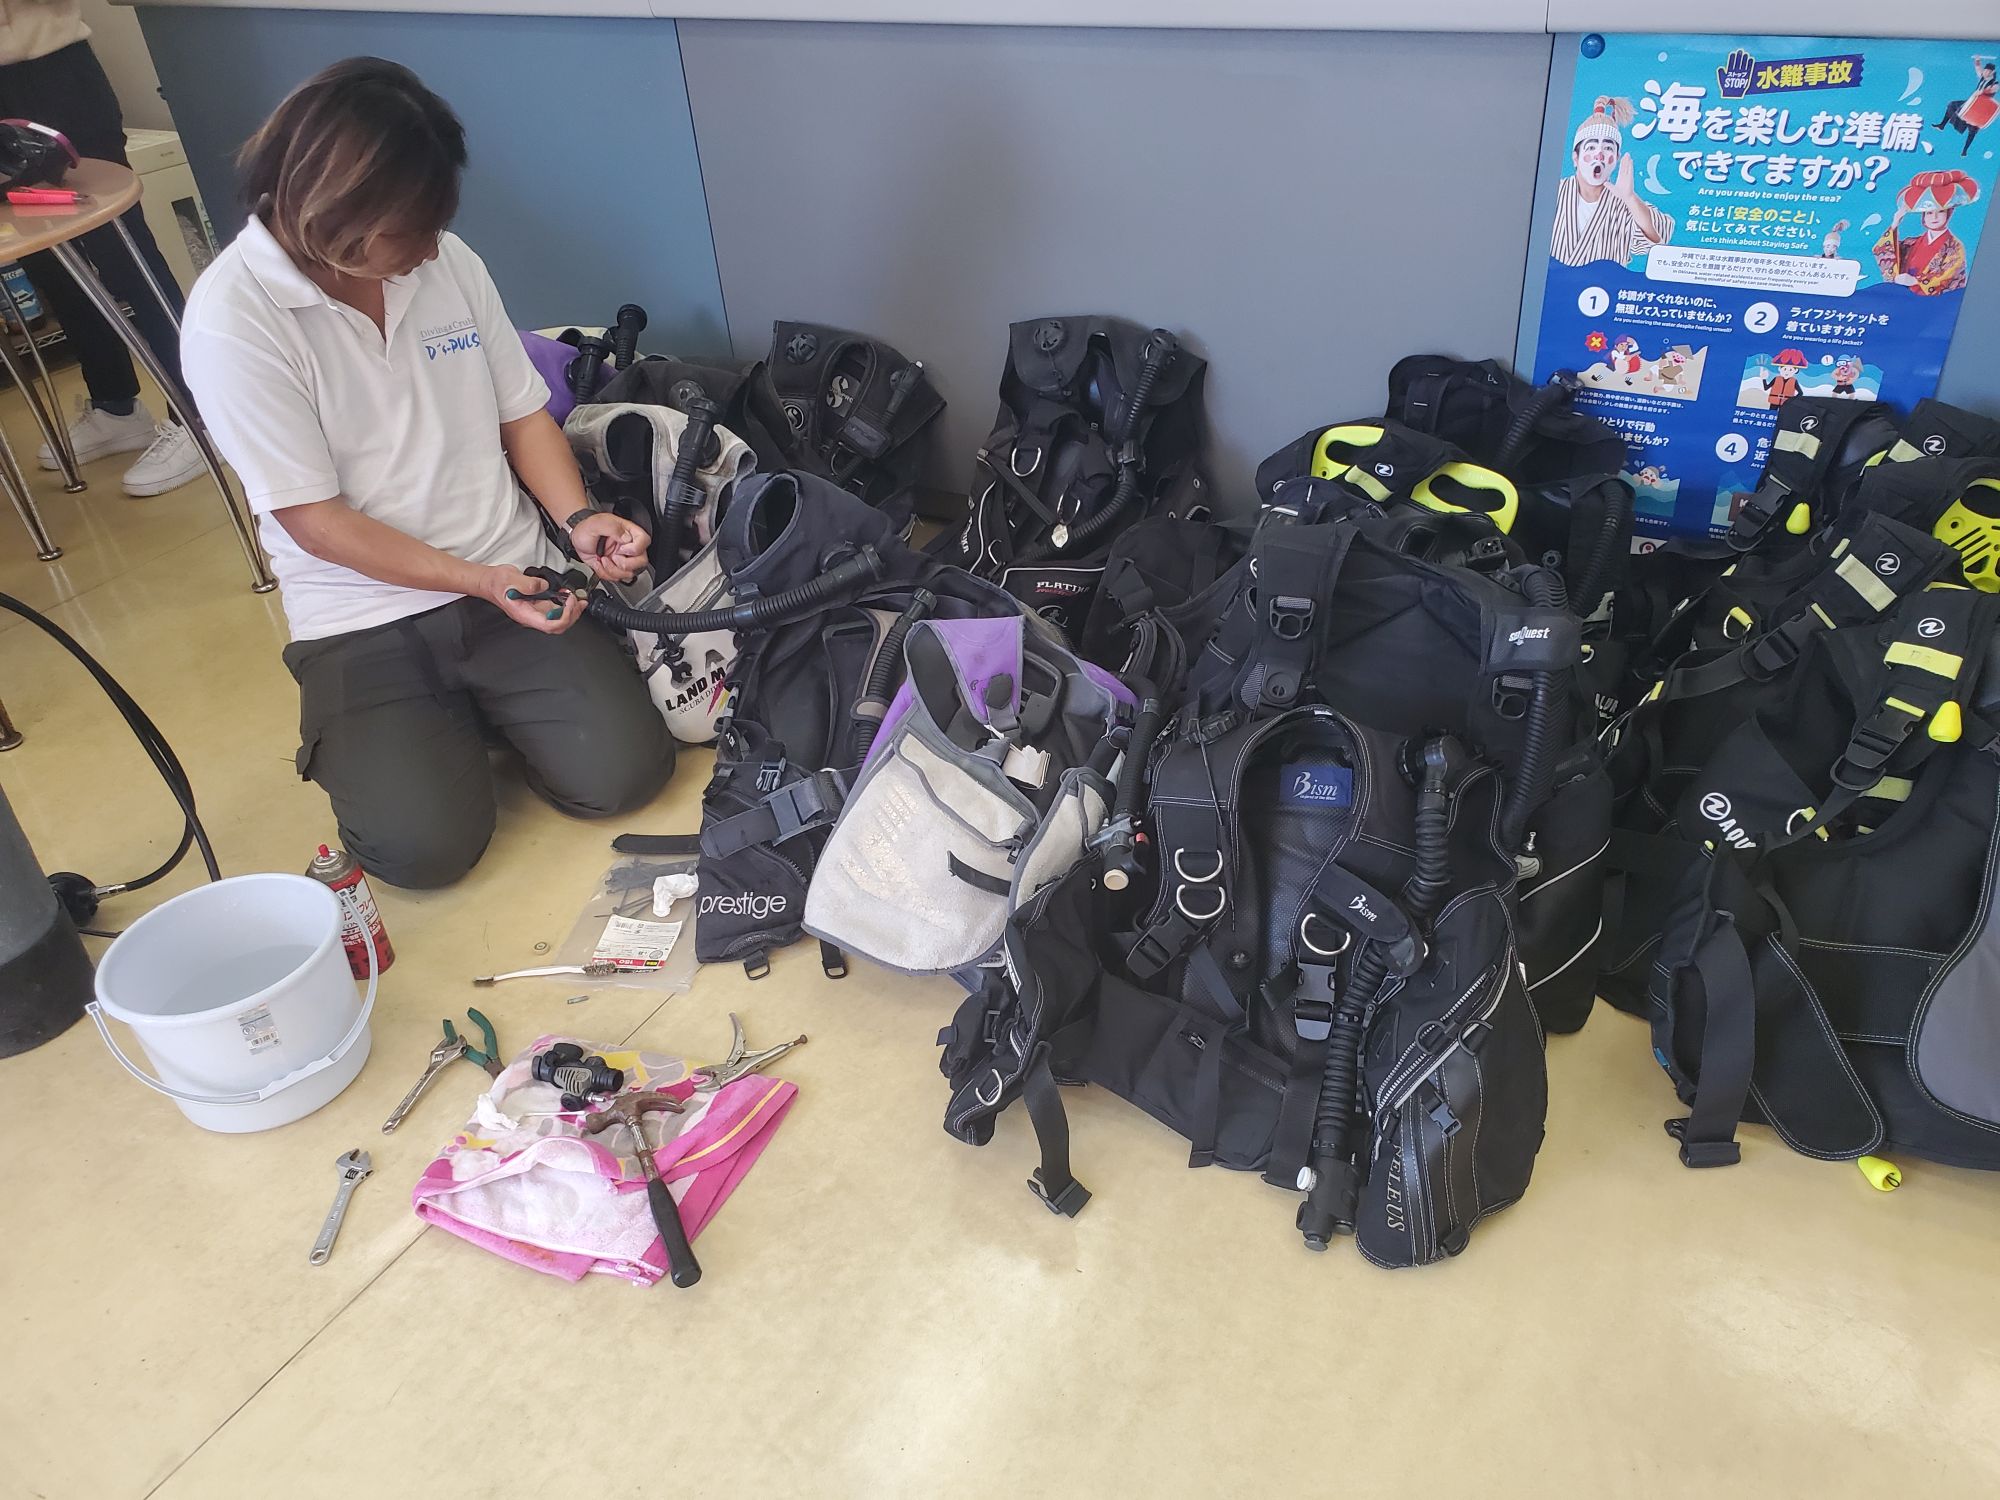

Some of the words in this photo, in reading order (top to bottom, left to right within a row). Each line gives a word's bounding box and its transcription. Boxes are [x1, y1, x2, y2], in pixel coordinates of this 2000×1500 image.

[1724, 78, 1748, 89] STOP!
[1756, 60, 1853, 89] 水難事故
[1631, 79, 1933, 154] 海を楽しむ準備、
[1715, 190, 1733, 198] you
[1734, 190, 1760, 199] ready
[1773, 192, 1800, 202] enjoy
[1801, 193, 1818, 201] the
[1819, 194, 1841, 203] sea?
[1685, 220, 1817, 239] 気にしてみてください。
[1739, 238, 1760, 246] about
[1762, 240, 1790, 250] Staying
[1791, 242, 1809, 250] Safe
[1754, 311, 1767, 326] 2
[1790, 307, 1890, 326] ライフジャケットを
[1724, 442, 1737, 456] 4
[665, 676, 708, 712] LAND
[1293, 771, 1338, 798] Bism
[697, 891, 787, 919] prestige
[1348, 894, 1378, 922] Bism
